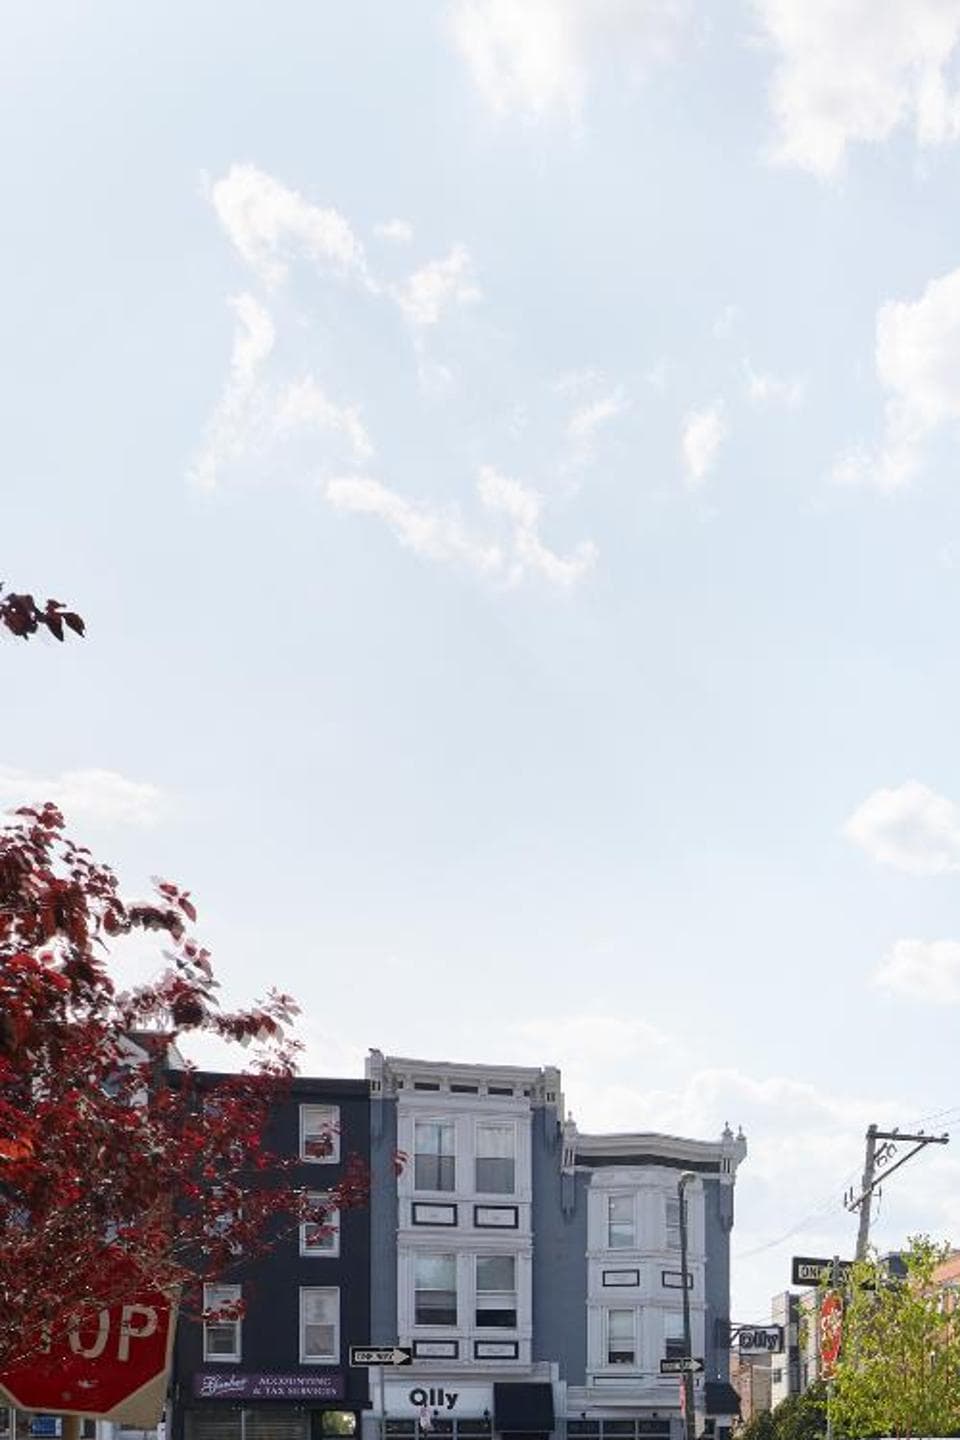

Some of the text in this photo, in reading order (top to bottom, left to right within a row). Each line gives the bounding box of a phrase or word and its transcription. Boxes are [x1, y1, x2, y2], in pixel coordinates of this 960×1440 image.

[740, 1330, 778, 1351] Olly
[259, 1377, 332, 1386] ACCOUNTING
[265, 1387, 285, 1396] TAX
[287, 1387, 337, 1396] SERVICES
